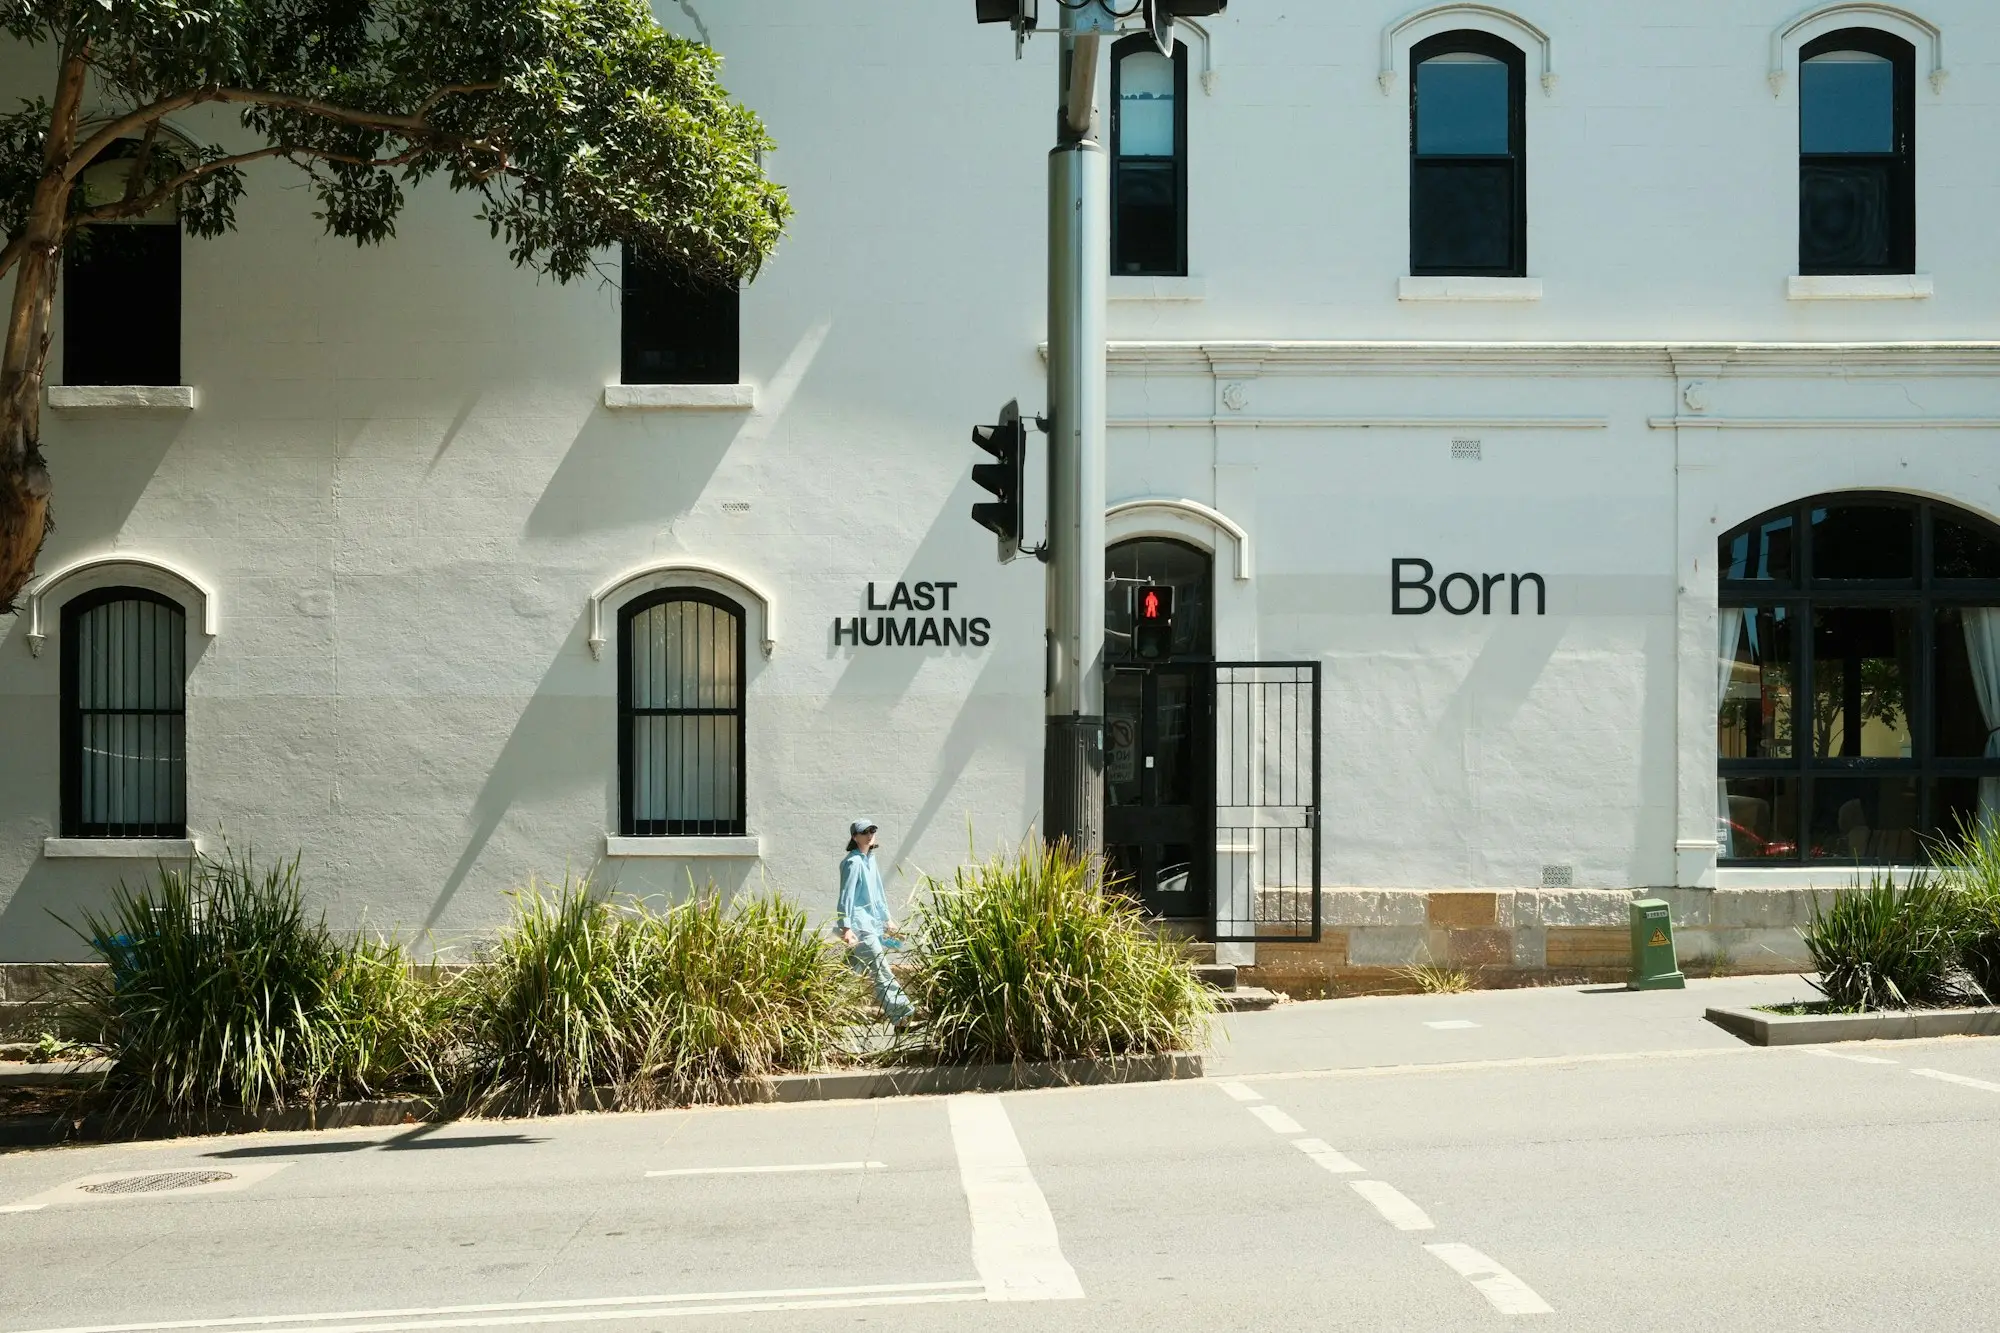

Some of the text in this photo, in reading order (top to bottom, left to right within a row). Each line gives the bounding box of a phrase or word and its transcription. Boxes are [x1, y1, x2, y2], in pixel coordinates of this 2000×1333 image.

[867, 581, 958, 611] LAST
[1391, 558, 1546, 616] Born
[834, 617, 991, 647] HUMANS
